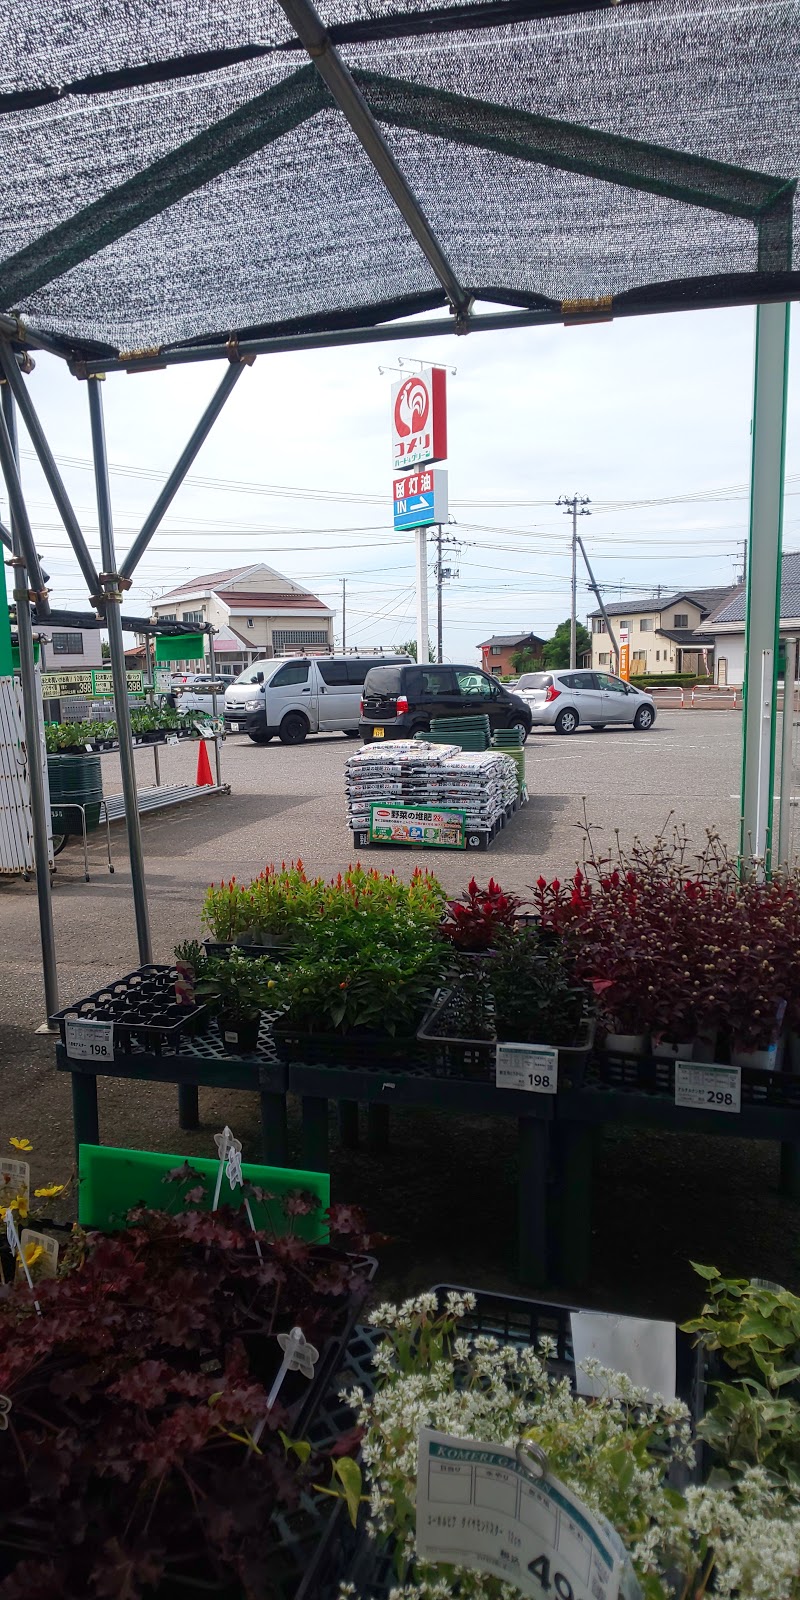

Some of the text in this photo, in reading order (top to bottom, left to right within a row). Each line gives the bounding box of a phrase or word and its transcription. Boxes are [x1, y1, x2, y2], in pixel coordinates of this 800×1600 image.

[395, 434, 430, 458] コメリ
[409, 473, 431, 495] 灯油
[397, 500, 407, 514] IN
[80, 682, 91, 693] 398
[128, 682, 141, 691] 398
[391, 810, 432, 821] 野菜の堆肥
[90, 1044, 107, 1055] 198
[528, 1074, 550, 1087] 198
[706, 1090, 733, 1105] 298
[437, 1446, 496, 1466] KOMERI
